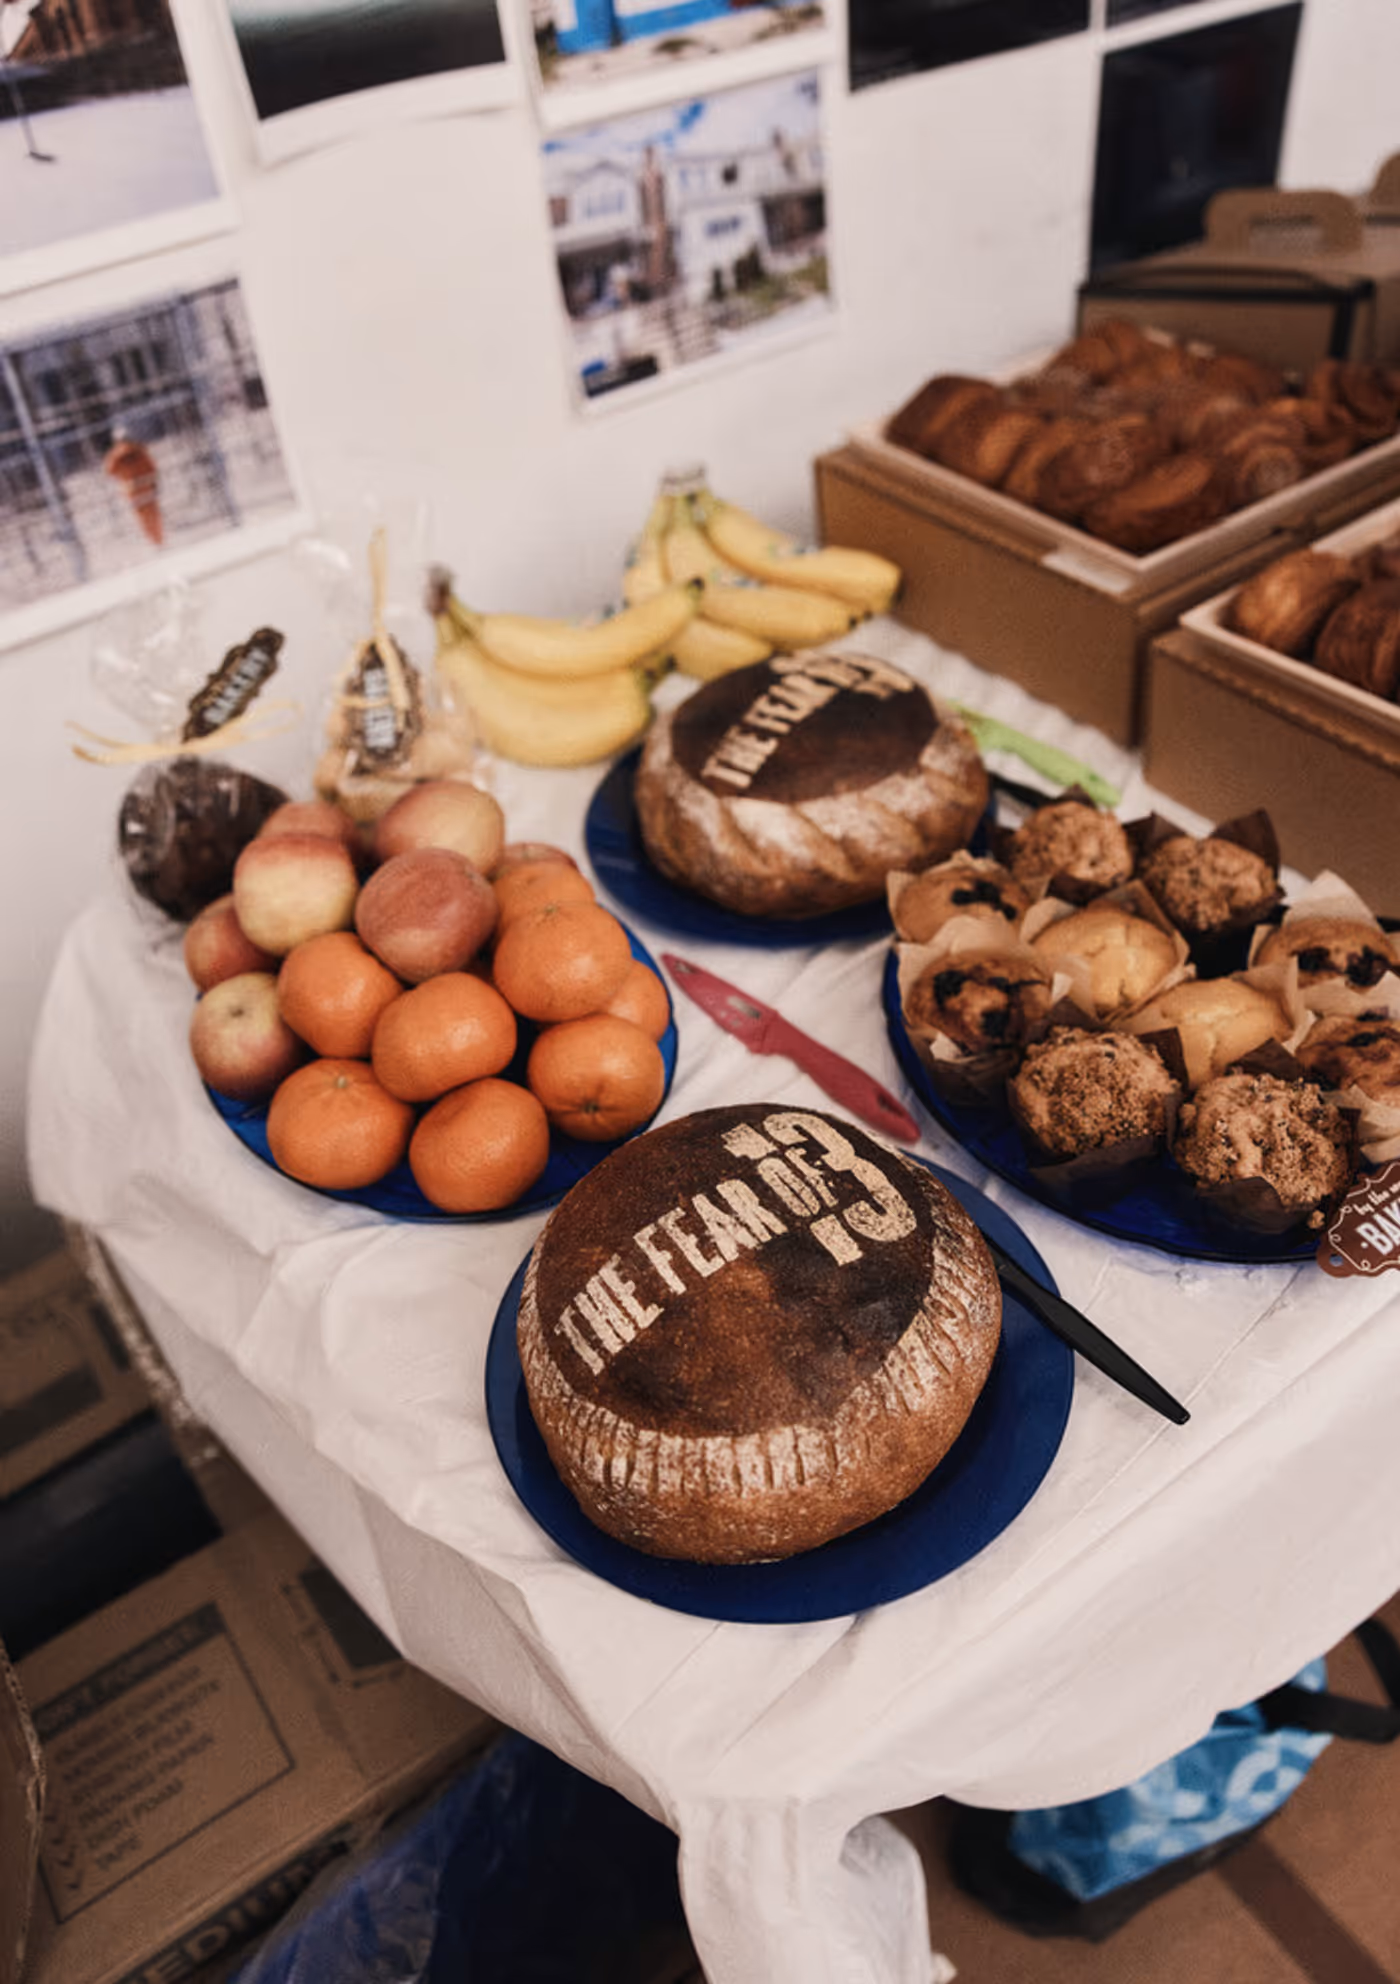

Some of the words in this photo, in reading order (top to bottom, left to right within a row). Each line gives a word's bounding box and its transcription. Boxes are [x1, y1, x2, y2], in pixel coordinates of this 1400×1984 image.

[554, 1254, 665, 1376] THE
[633, 1179, 789, 1295] FEAR
[757, 1147, 839, 1217] OF
